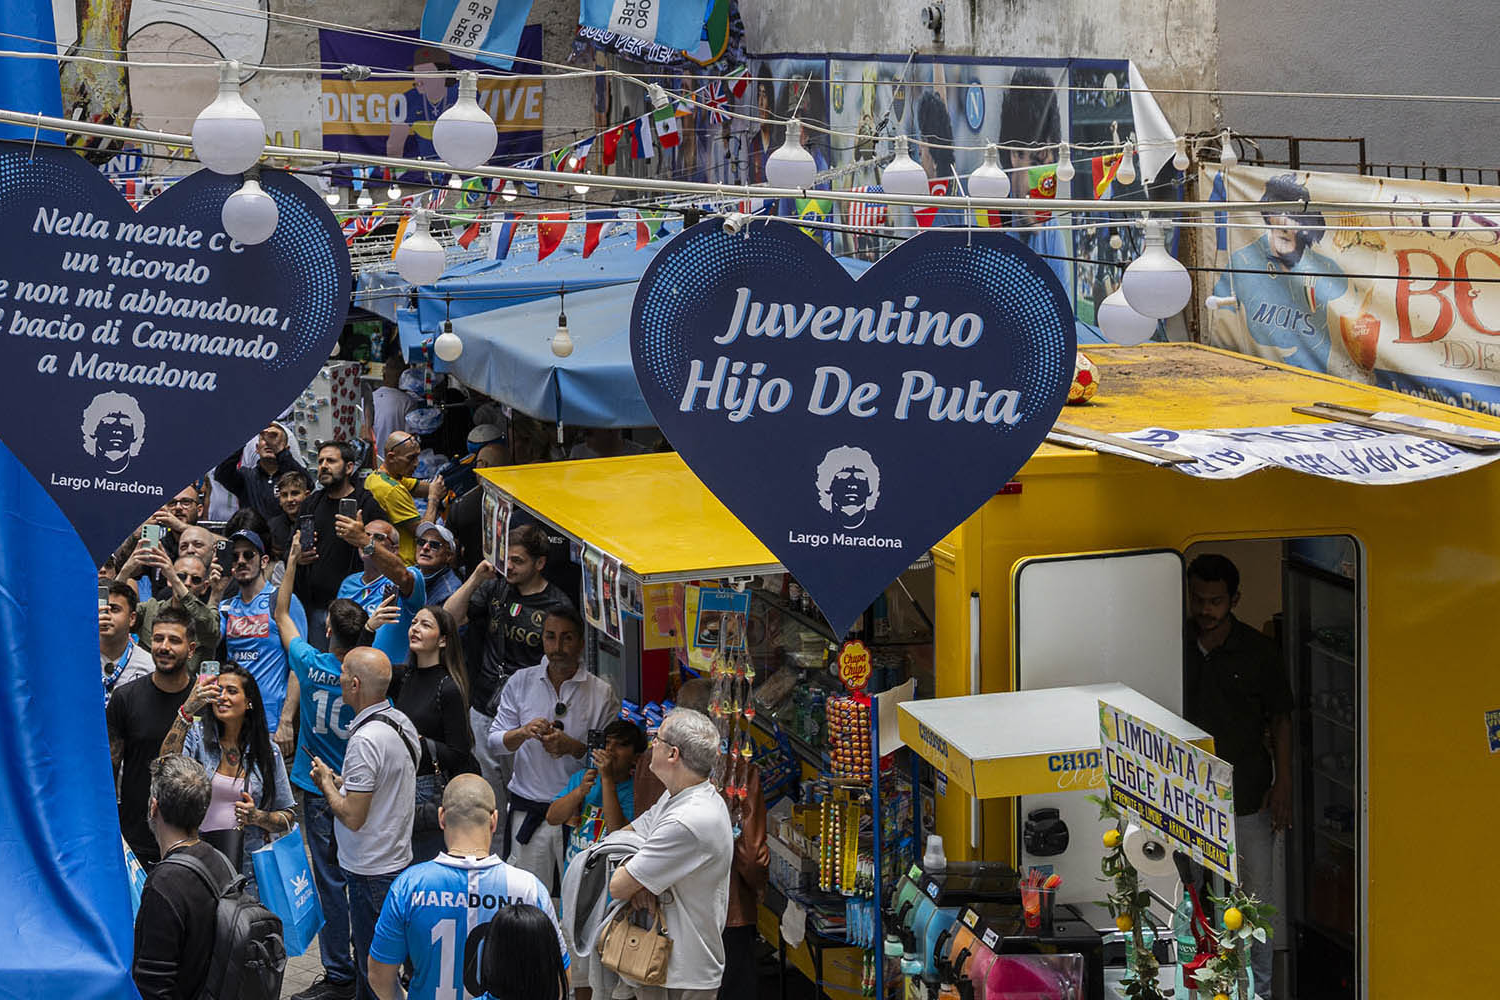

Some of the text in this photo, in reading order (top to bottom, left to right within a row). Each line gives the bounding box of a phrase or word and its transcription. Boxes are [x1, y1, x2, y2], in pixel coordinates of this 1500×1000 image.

[323, 92, 408, 124] DIEGO
[33, 207, 109, 240] Nella
[116, 219, 202, 249] mente
[62, 250, 210, 285] un ricordo
[14, 281, 68, 305] non
[75, 284, 115, 310] mi
[713, 287, 985, 348] Juventino
[1253, 302, 1316, 337] Mars
[9, 311, 85, 342] bacio
[92, 319, 122, 346] di
[132, 321, 279, 361] Carmando
[37, 351, 217, 392] a Maradona
[679, 356, 1024, 425] Hijo De Puta
[50, 473, 164, 496] Largo Maradona
[789, 529, 903, 550] Largo Maradona
[504, 624, 541, 647] MSC
[843, 653, 867, 666] Chupa
[843, 663, 867, 678] Chups
[1114, 711, 1198, 785] LIMONATA
[1106, 746, 1156, 801] COSCE
[1163, 777, 1228, 844] APERTE
